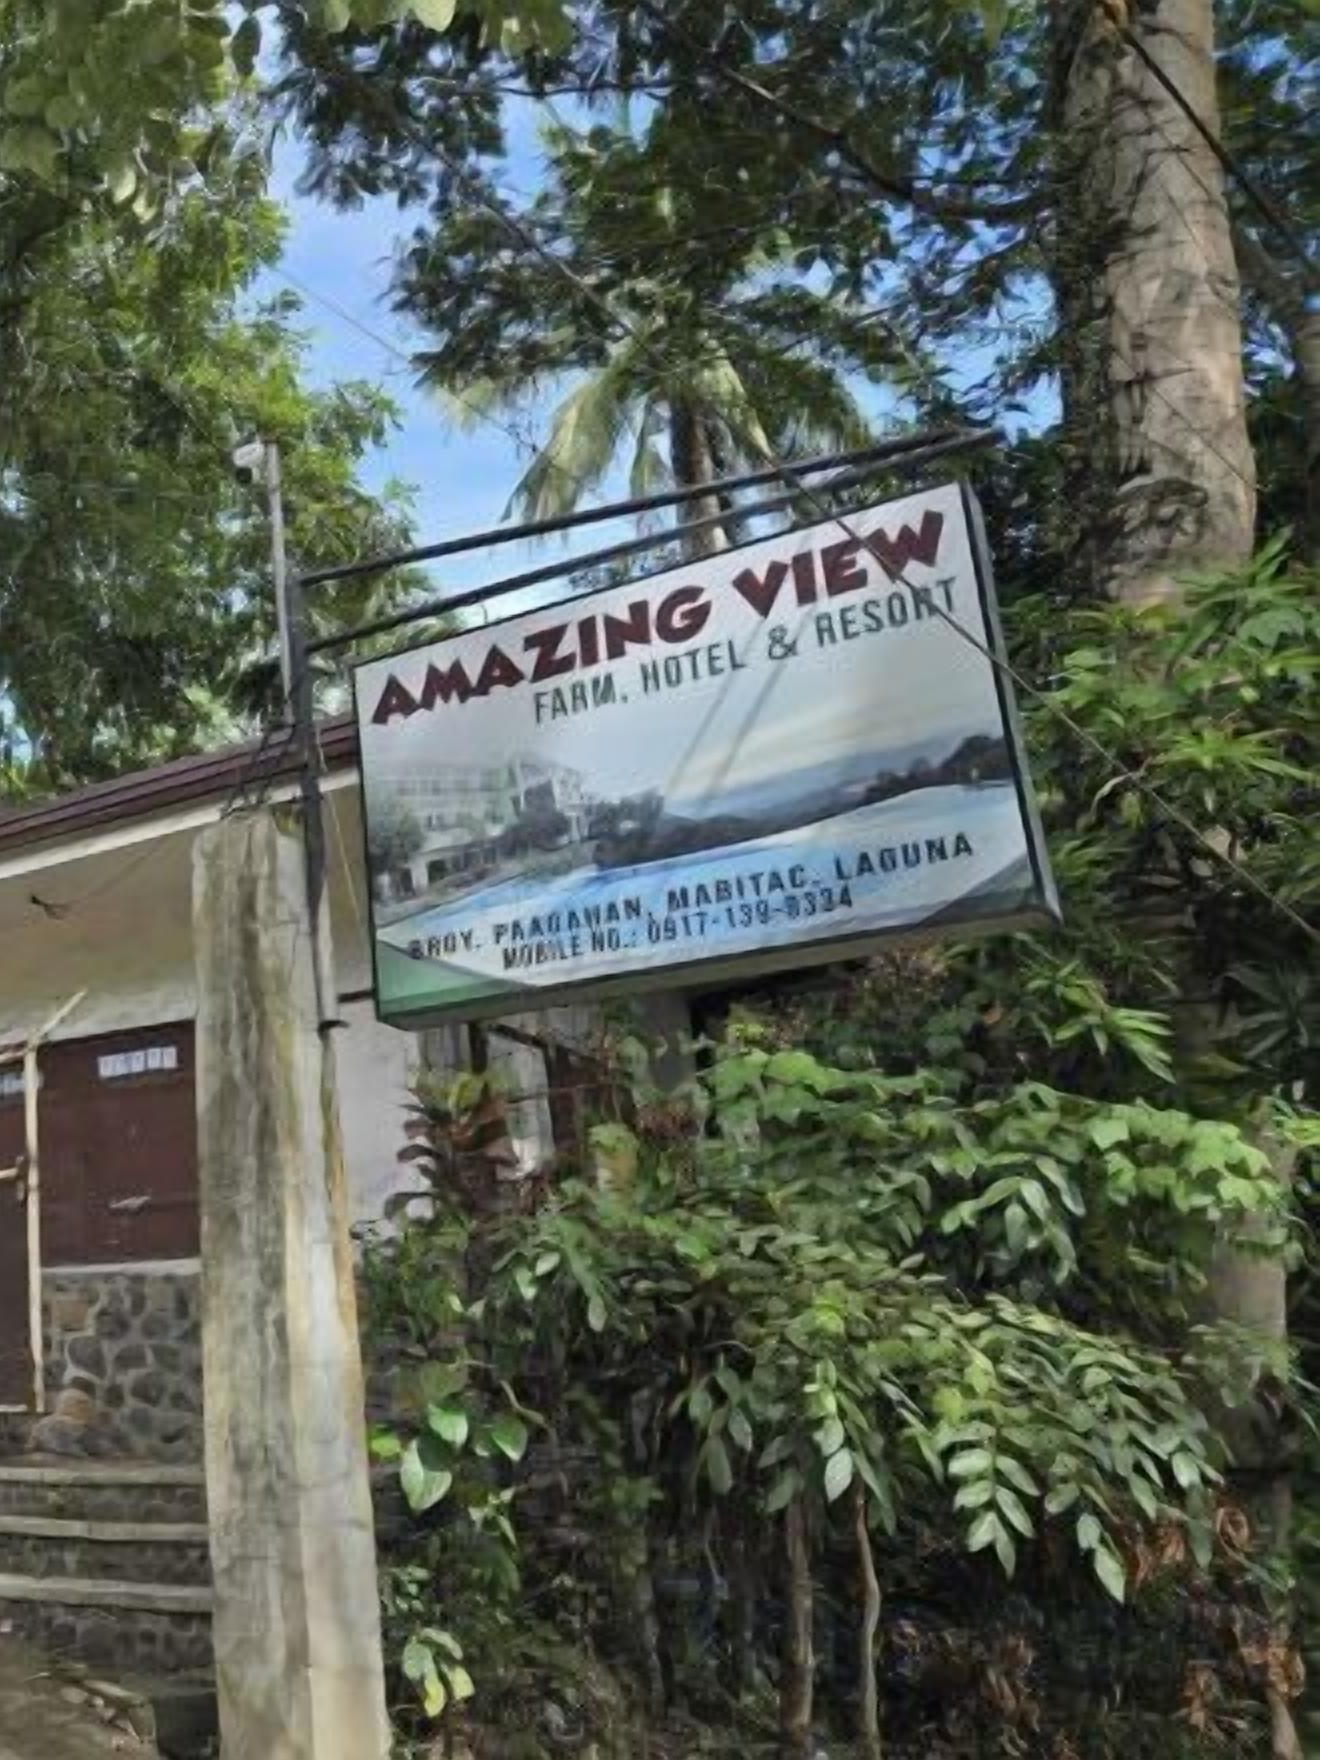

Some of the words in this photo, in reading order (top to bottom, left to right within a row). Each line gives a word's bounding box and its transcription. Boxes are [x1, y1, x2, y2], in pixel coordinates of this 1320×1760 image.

[372, 584, 712, 724] AMAZING
[732, 510, 944, 619] VIEW
[641, 639, 746, 694] HOTEL
[767, 623, 798, 660] &
[815, 577, 956, 648] RESORT
[834, 831, 974, 881] LAGUNA
[502, 942, 583, 970] MOBILE
